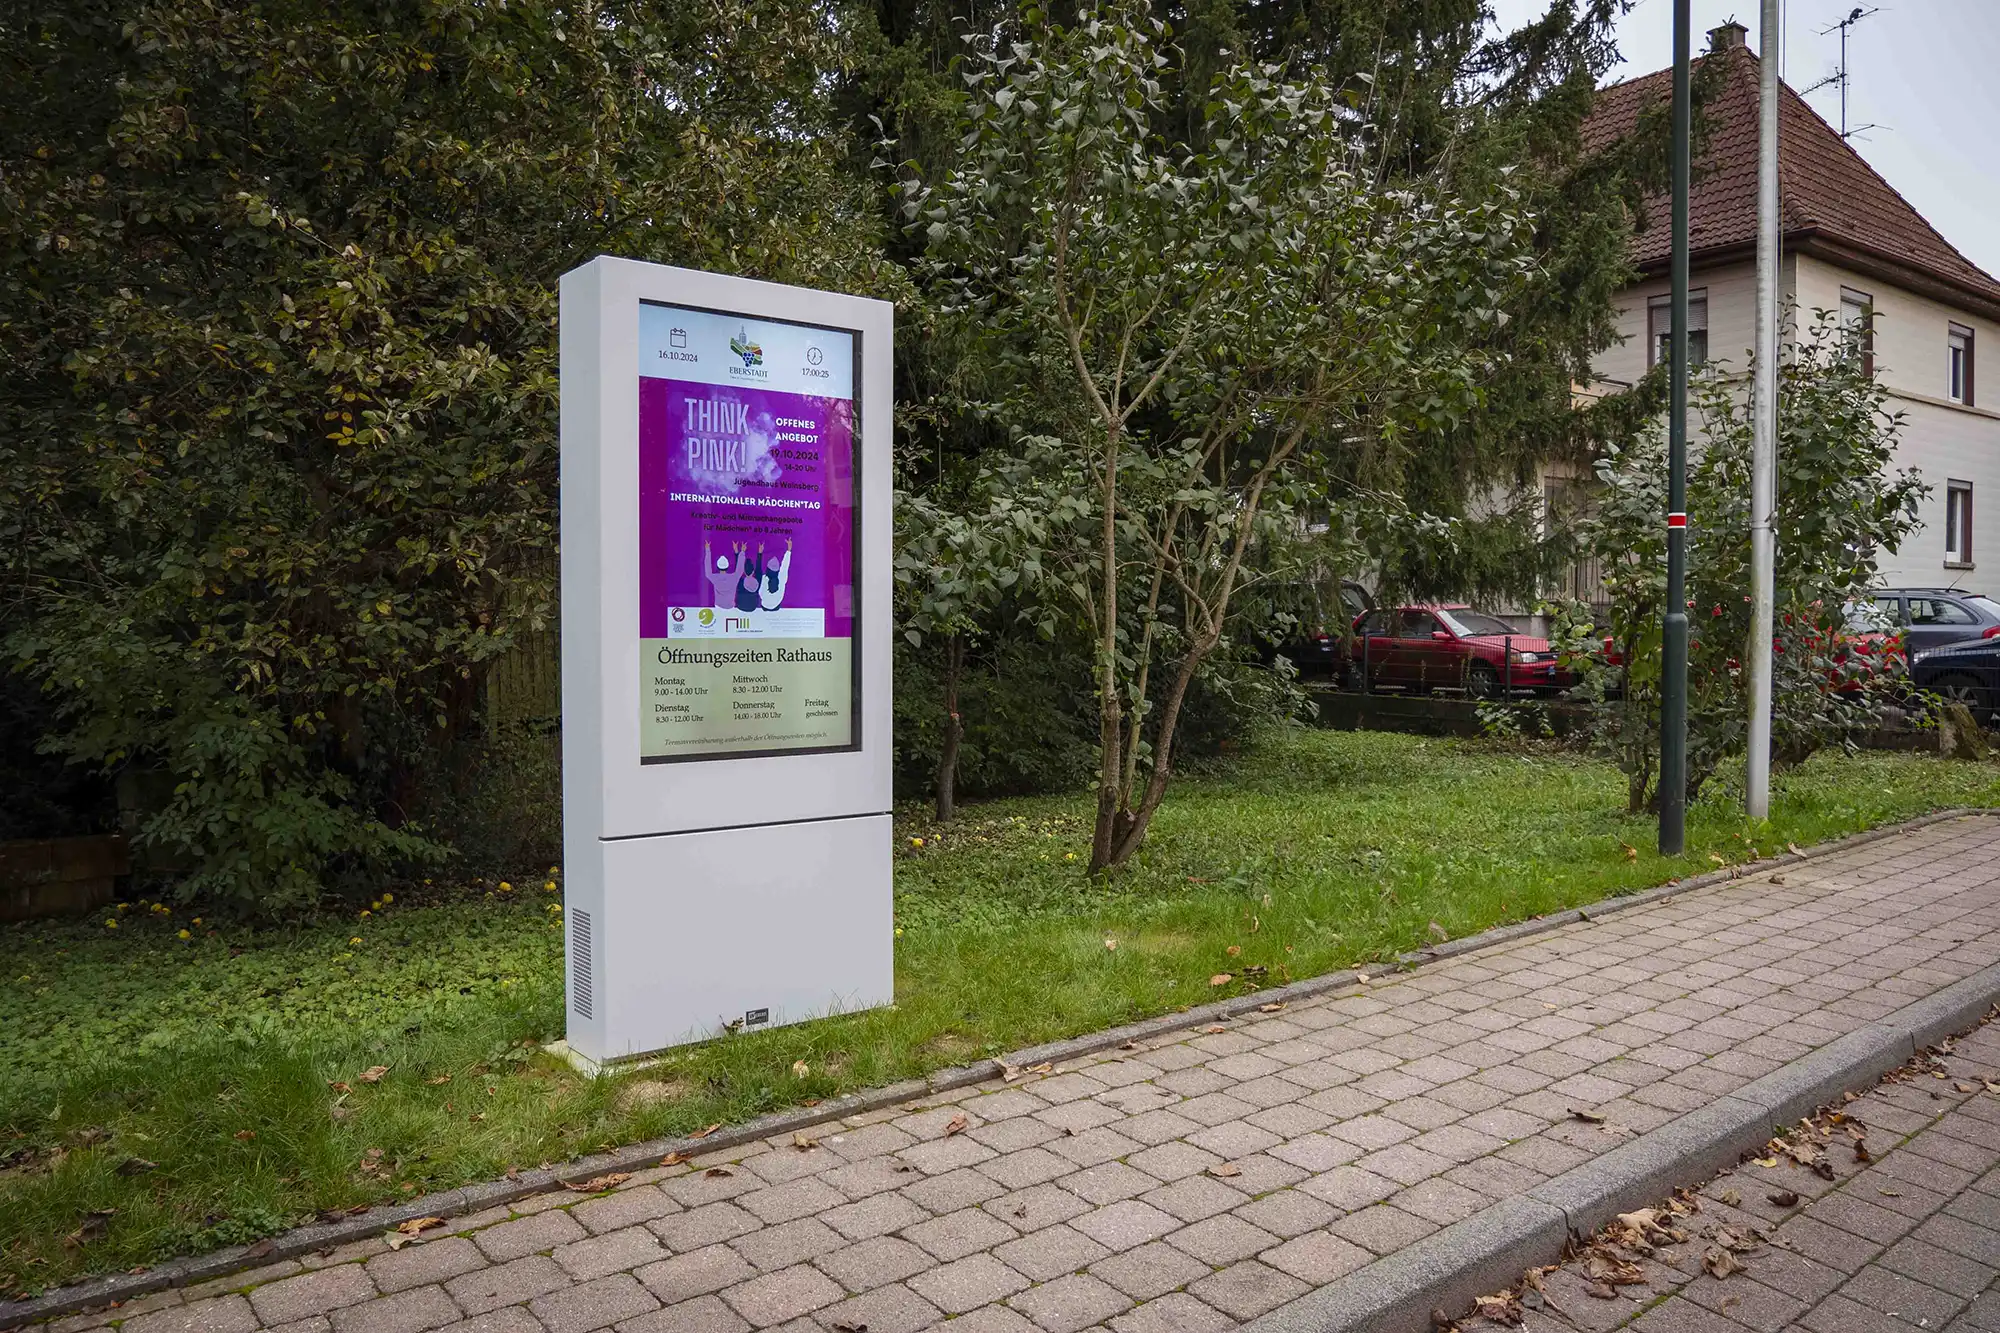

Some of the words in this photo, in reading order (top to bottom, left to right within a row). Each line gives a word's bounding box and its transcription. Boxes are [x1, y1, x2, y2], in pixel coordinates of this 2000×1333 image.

[658, 350, 698, 362] 16.10.2024
[729, 366, 768, 378] EBERSTADT
[802, 368, 829, 378] 17:00:25
[684, 398, 749, 435] THINK
[775, 417, 815, 429] OFFENES
[775, 432, 819, 444] ANGEBOT
[688, 437, 746, 473] PINK!
[770, 449, 819, 461] 19.10.2024
[733, 478, 778, 488] Jugendhaus
[780, 482, 819, 492] Weinsberg
[670, 492, 756, 506] INTERNATIONALER
[658, 646, 773, 668] Öffnungszeiten
[776, 648, 833, 663] Rathaus
[654, 677, 686, 686] Montag
[732, 675, 769, 684] Mittwoch
[675, 688, 693, 696] 14.00
[694, 687, 709, 695] Uhr
[732, 686, 747, 694] 8.30
[770, 685, 783, 693] Uhr
[655, 704, 690, 712] Dienstag
[732, 701, 775, 710] Donnerstag
[804, 698, 830, 707] Freitag
[806, 710, 839, 718] geschlossen
